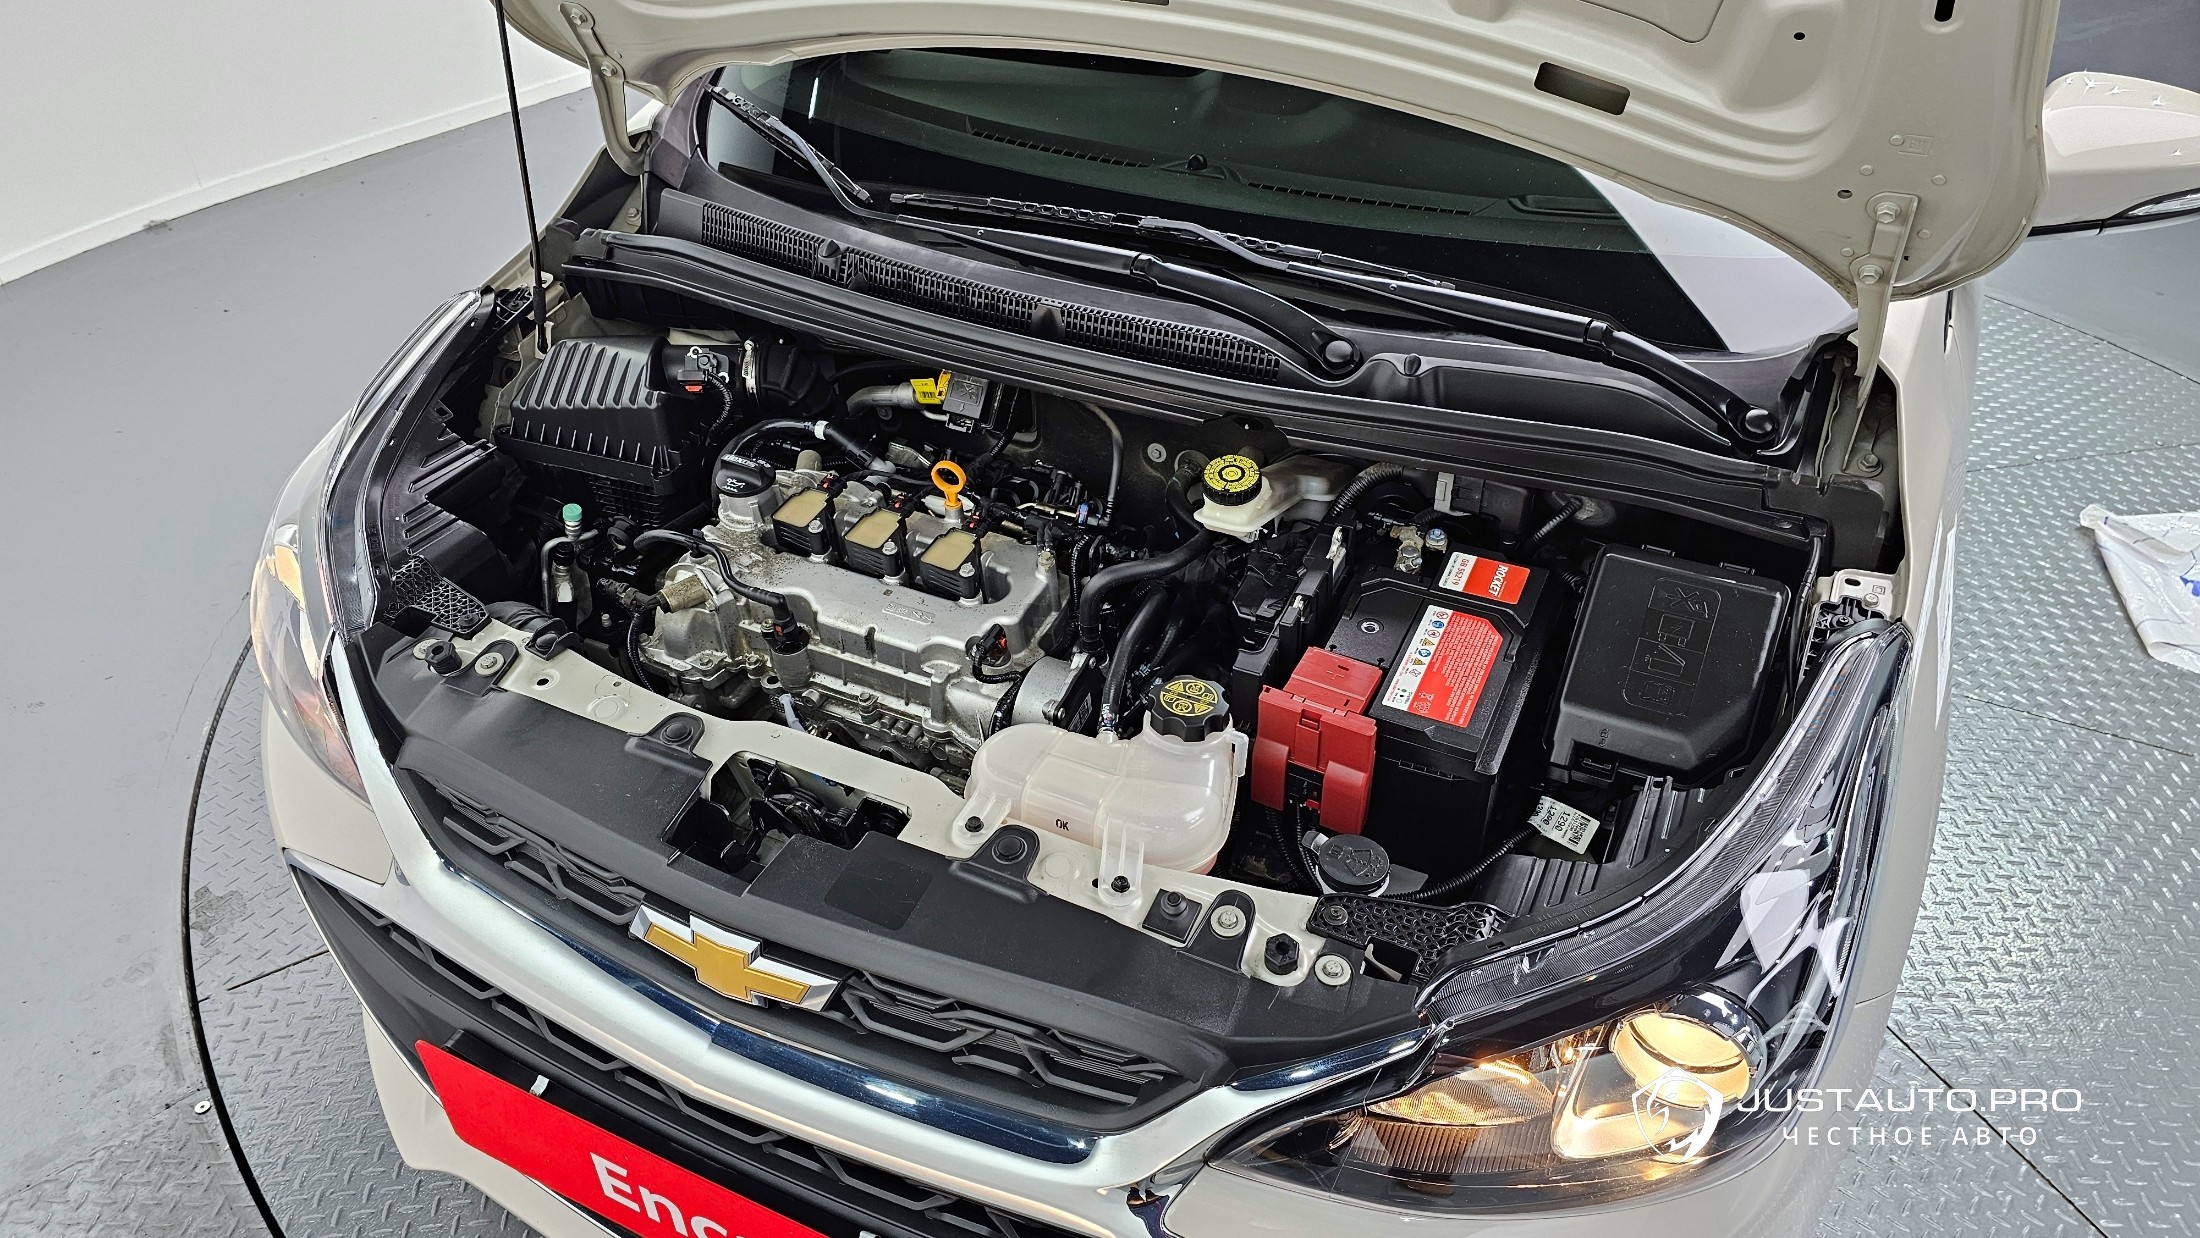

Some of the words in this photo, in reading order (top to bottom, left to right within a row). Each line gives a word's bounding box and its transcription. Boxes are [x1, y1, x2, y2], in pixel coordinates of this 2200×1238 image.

[1488, 564, 1509, 597] ROCKET
[1055, 818, 1070, 832] OK
[1554, 811, 1571, 832] 1290
